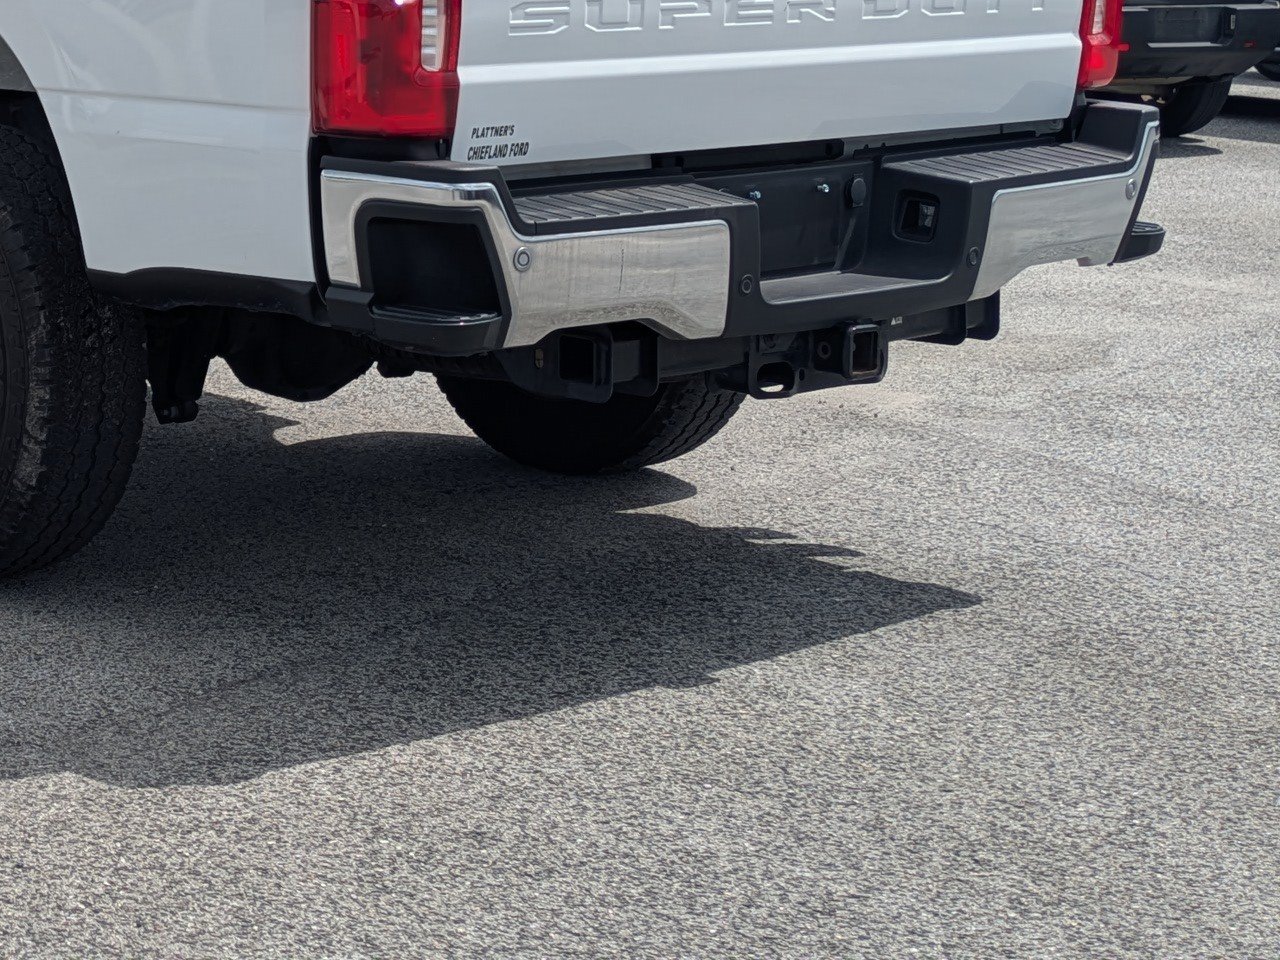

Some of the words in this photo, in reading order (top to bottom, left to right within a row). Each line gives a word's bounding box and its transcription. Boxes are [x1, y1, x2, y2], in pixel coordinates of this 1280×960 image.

[470, 125, 515, 139] PLATTNER'S
[467, 144, 508, 161] CHIEFLAND
[508, 141, 530, 157] FORD
